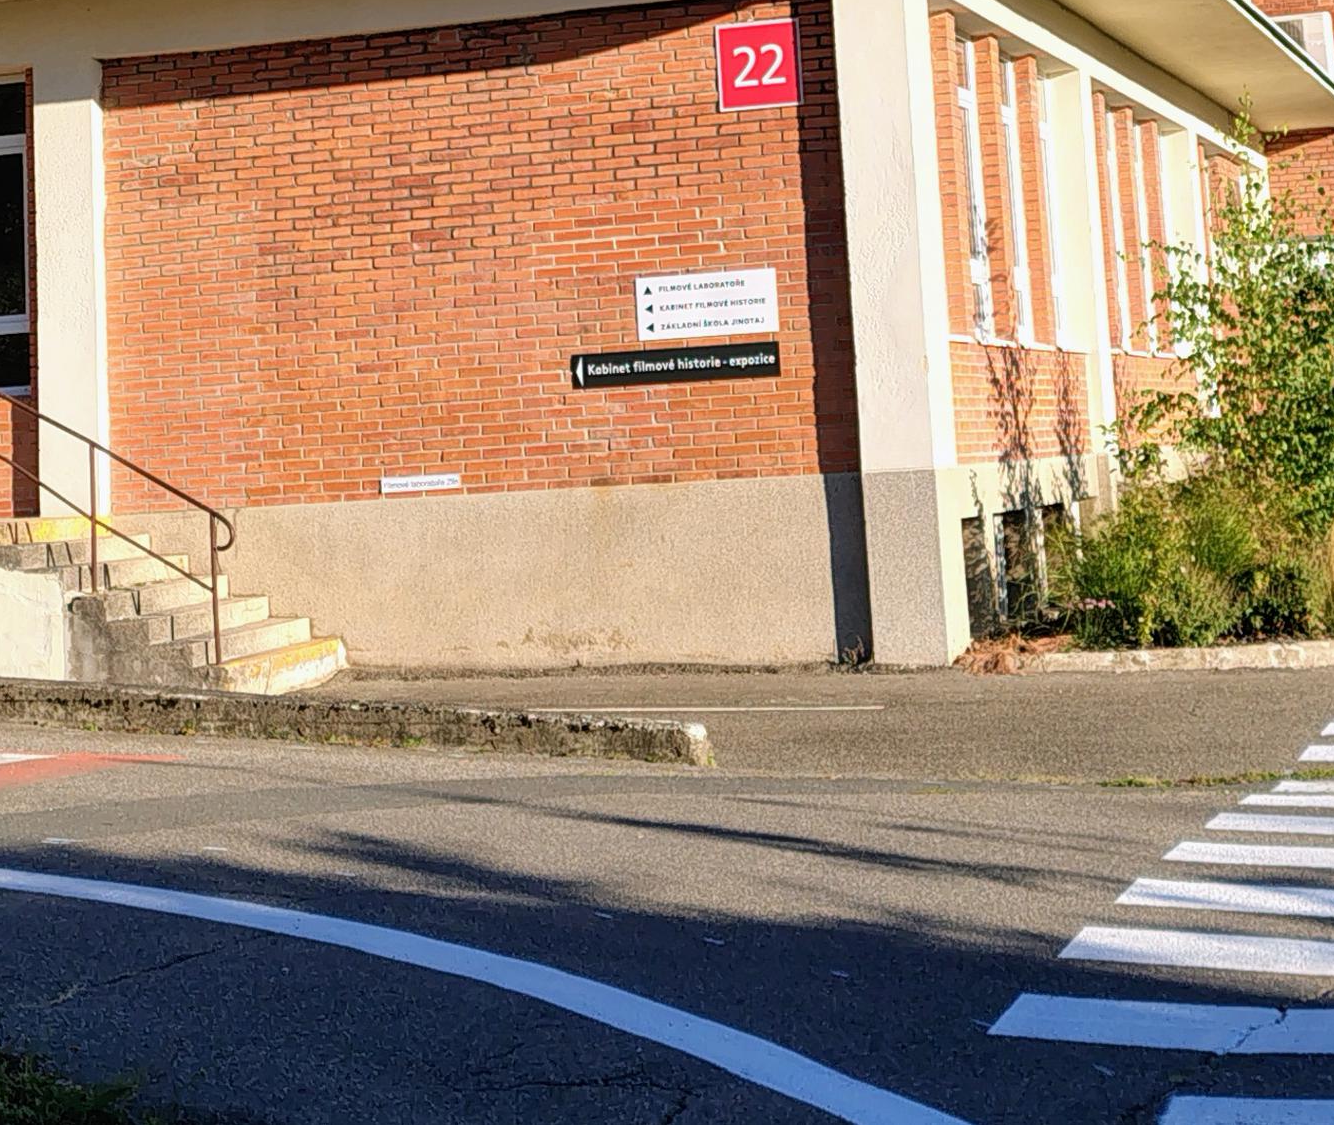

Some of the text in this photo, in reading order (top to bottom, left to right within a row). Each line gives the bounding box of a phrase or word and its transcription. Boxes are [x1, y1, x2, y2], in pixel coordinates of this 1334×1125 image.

[733, 43, 787, 88] 22
[658, 278, 745, 293] FILMOVÉ LABORATOŘE
[659, 297, 766, 312] KABINET FILMOVÉ HISTORIE
[661, 319, 702, 331] ZÁKLADNÍ
[703, 317, 729, 328] ŠKOLA
[587, 362, 632, 376] Kabinet
[633, 358, 676, 373] filmové
[677, 355, 721, 370] historie
[729, 352, 777, 368] expozice
